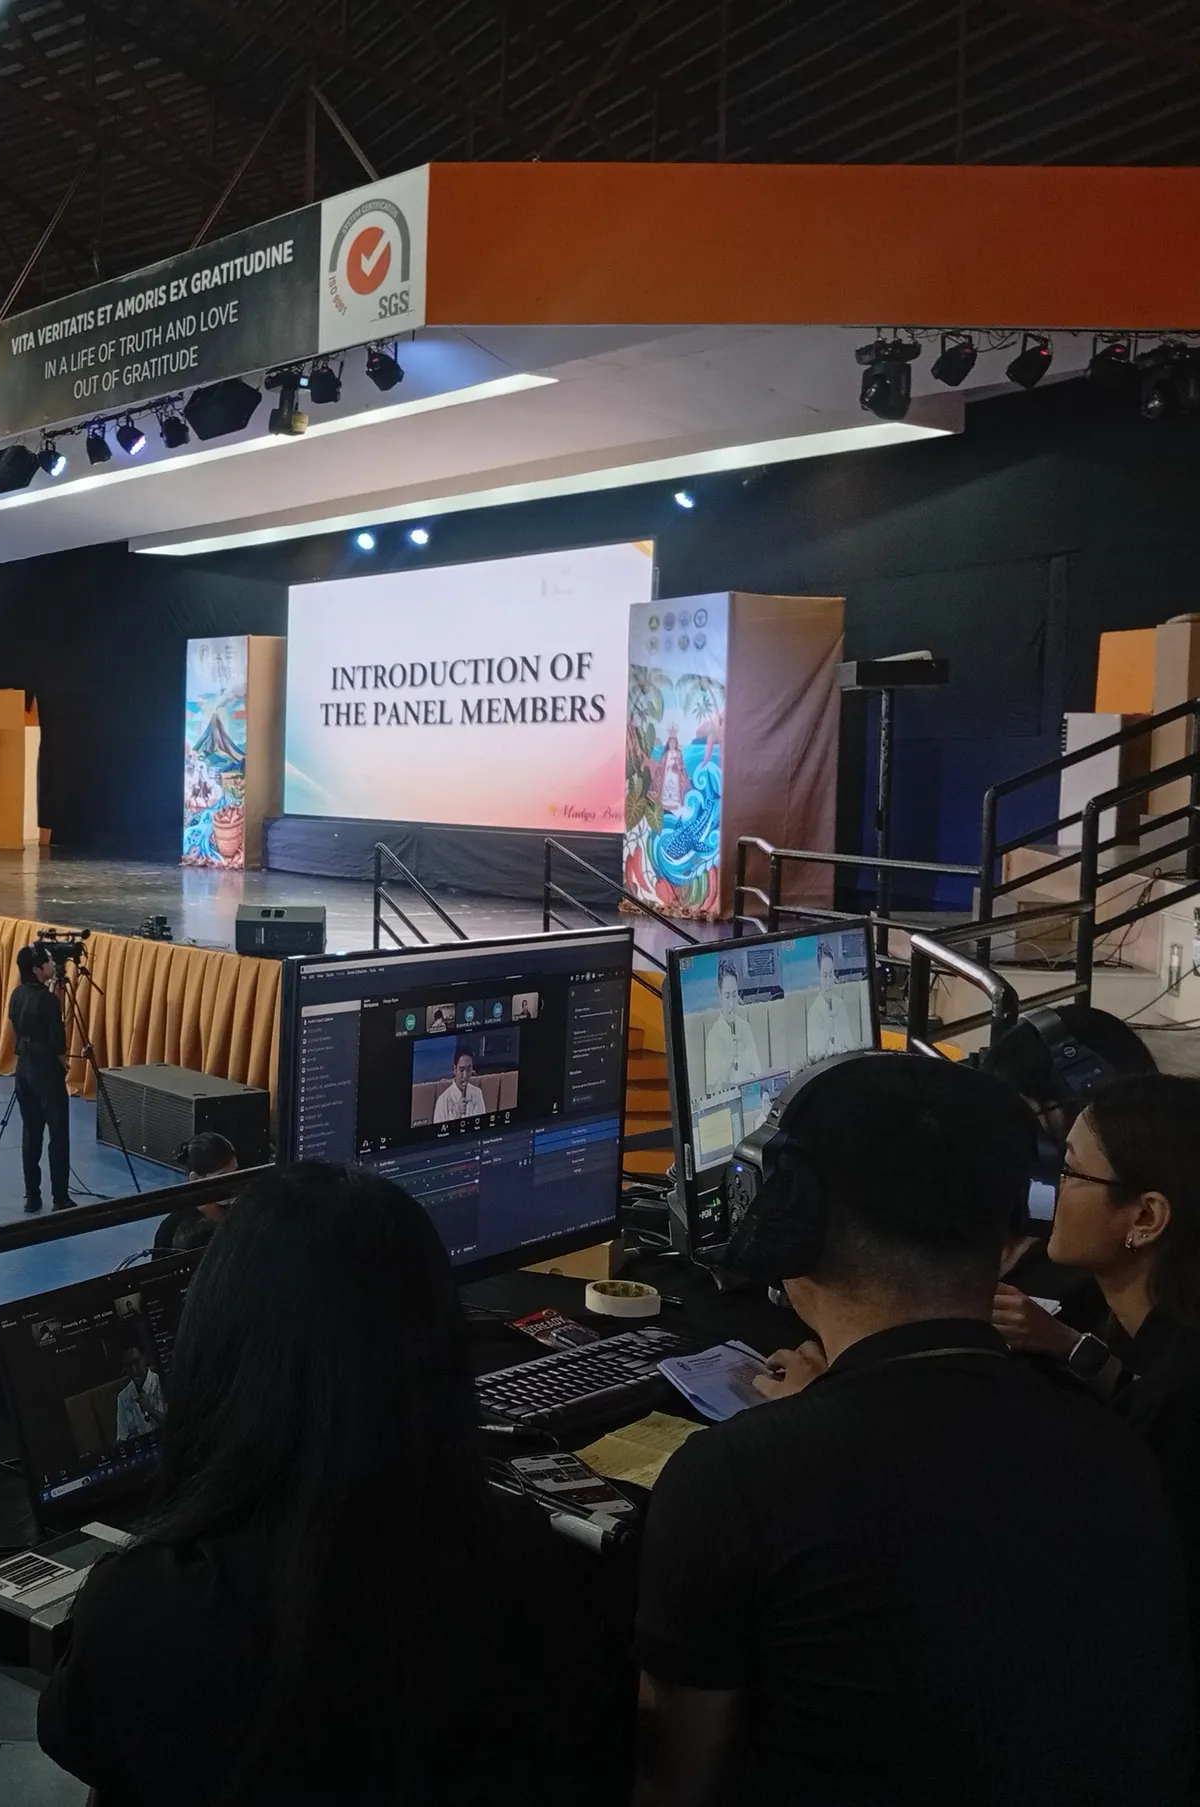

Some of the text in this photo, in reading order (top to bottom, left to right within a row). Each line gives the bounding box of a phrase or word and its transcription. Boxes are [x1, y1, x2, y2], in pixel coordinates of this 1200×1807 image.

[11, 239, 294, 356] VITA VERITATIS ET AMORIS EX GRATITUDINE
[328, 275, 337, 295] ISO
[378, 290, 409, 319] SGS
[44, 300, 239, 380] IN A LIFE OF TRUTH AND LOVE
[73, 346, 199, 400] OUT OF GRATITUDE
[331, 651, 593, 692] INTRODUCTION OF
[320, 694, 606, 728] THE PANEL MEMBERS
[519, 1314, 567, 1335] EVEREADY
